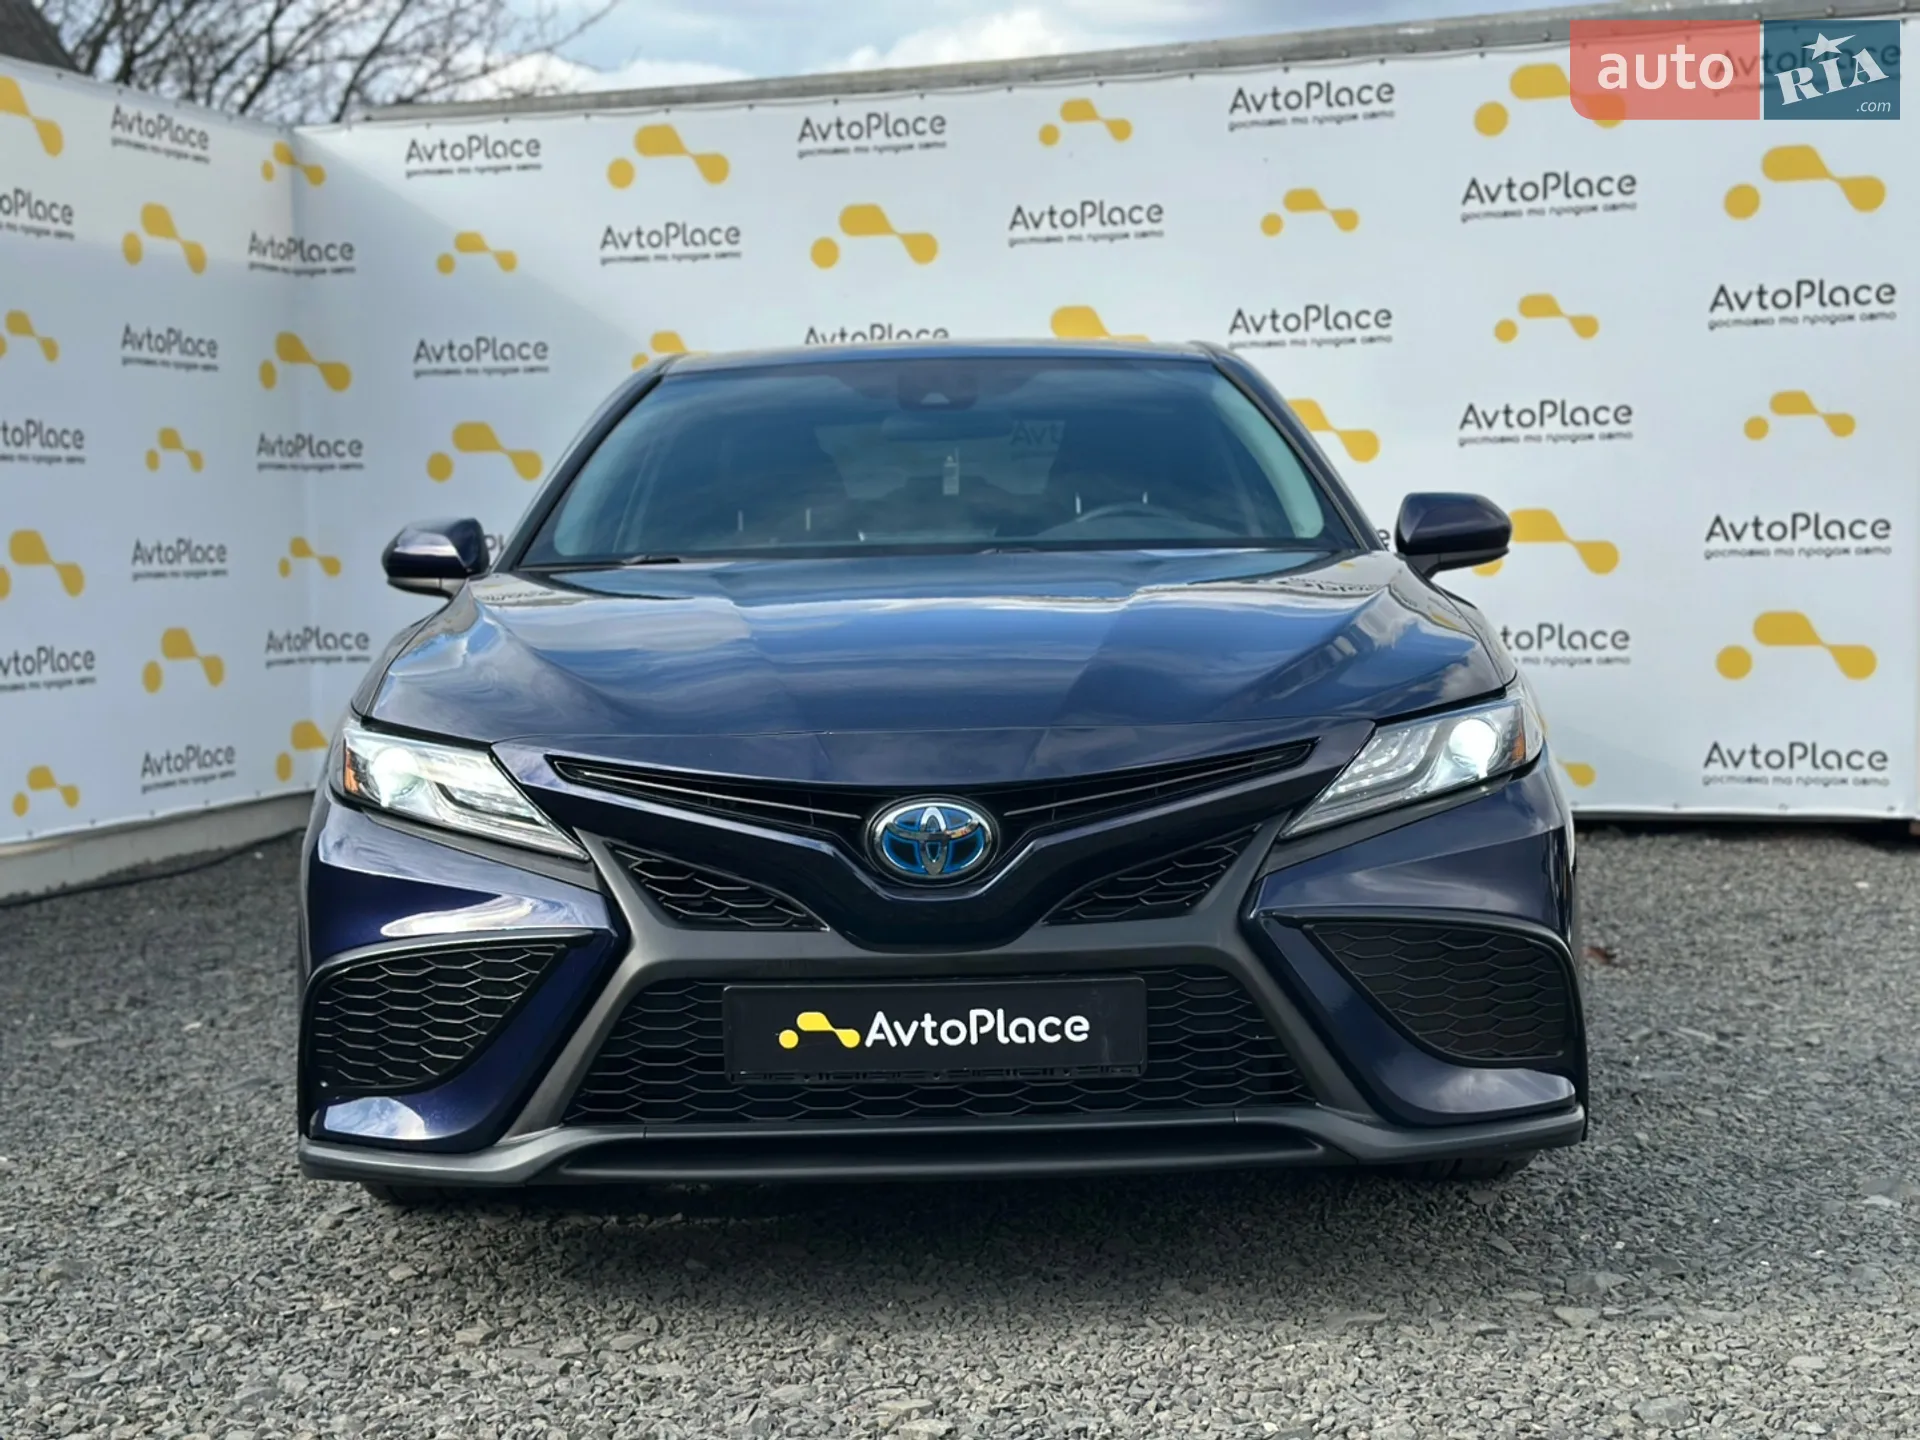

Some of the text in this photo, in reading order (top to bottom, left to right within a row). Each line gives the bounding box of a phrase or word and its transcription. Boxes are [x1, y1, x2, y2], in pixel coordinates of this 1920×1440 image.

[1229, 81, 1395, 114] AvtoPlace
[111, 104, 210, 151] AvtoPlace
[798, 112, 946, 143] AvtoPlace
[405, 134, 541, 164] AvtoPlace
[1462, 171, 1636, 205] AvtoPlace
[1009, 200, 1164, 230] AvtoPlace
[248, 232, 355, 263] AvtoPlace
[600, 222, 740, 250] AvtoPlace
[1710, 279, 1896, 312] AvtoPlace
[1229, 304, 1392, 334] AvtoPlace
[121, 324, 218, 359] AvtoPlace
[413, 336, 548, 363] AvtoPlace
[1460, 400, 1632, 430] AvtoPlace
[257, 433, 363, 459] AvtoPlace
[1705, 512, 1891, 542] AvtoPlace
[131, 538, 227, 565] AvtoPlace
[265, 626, 370, 653] AvtoPlace
[1501, 623, 1630, 651] toPlace
[141, 744, 235, 778] AvtoPlace
[1704, 741, 1888, 771] AvtoPlace
[865, 1008, 1090, 1047] AvtoPlace
